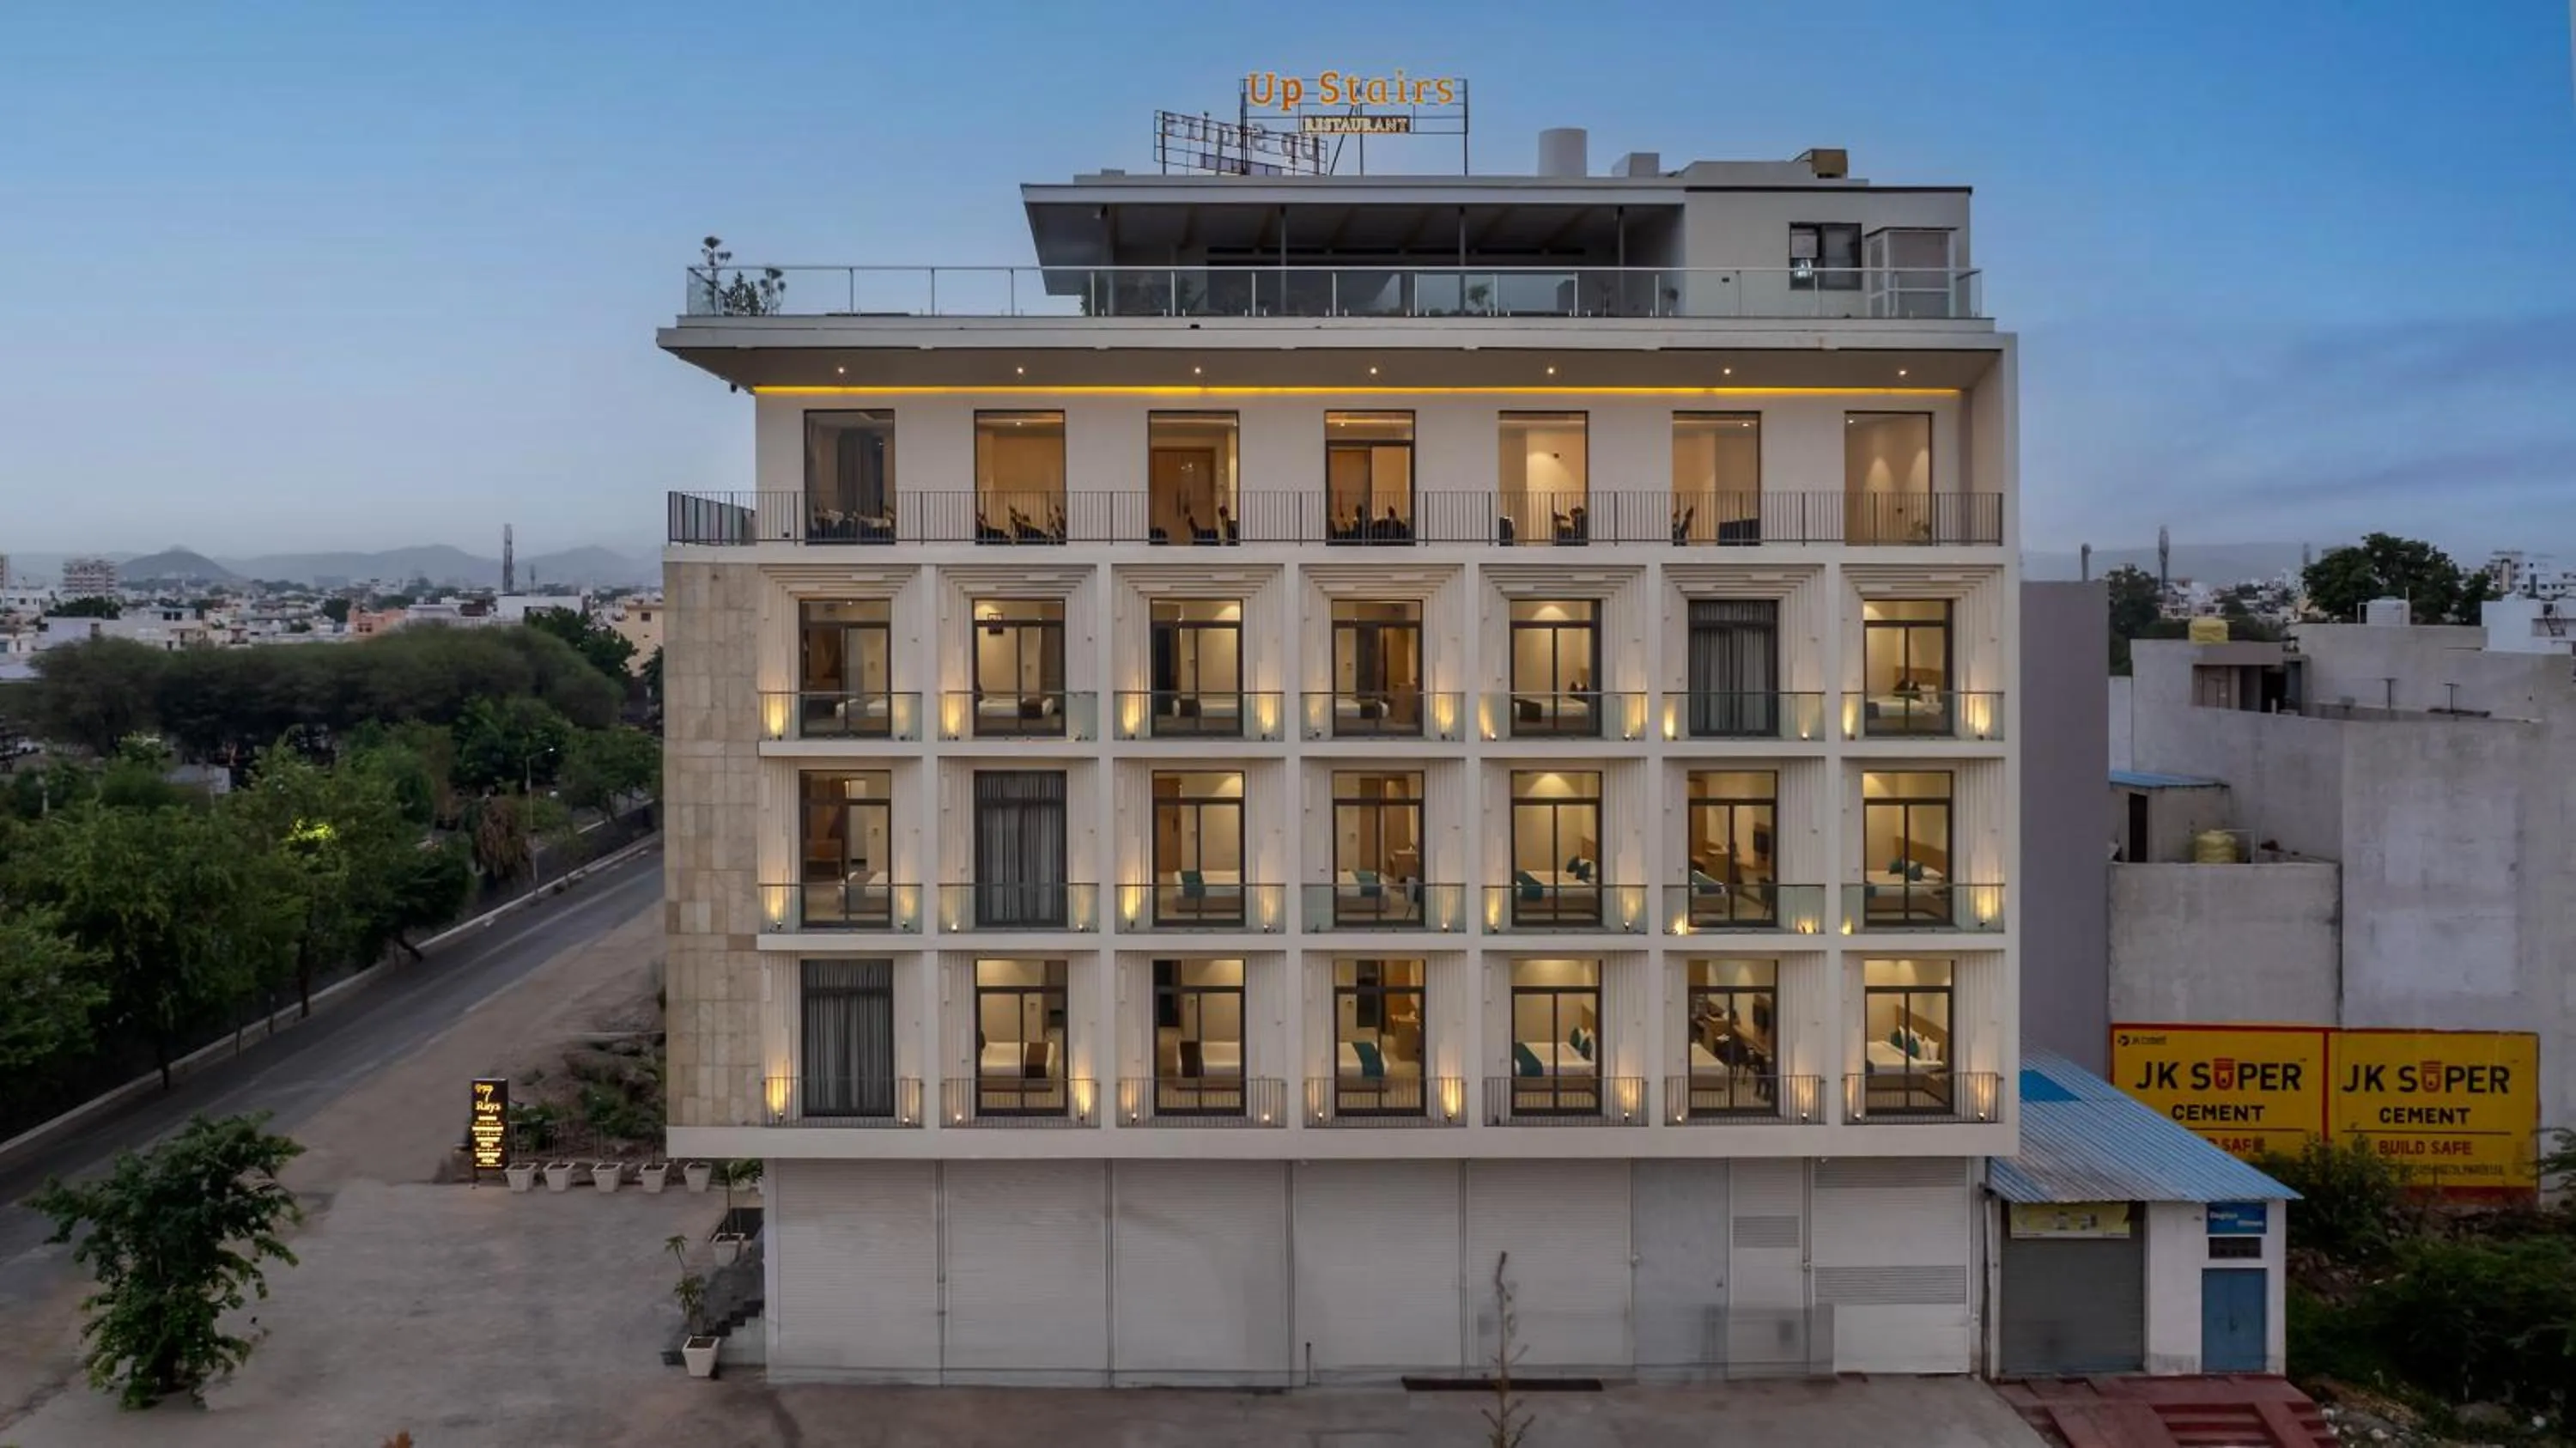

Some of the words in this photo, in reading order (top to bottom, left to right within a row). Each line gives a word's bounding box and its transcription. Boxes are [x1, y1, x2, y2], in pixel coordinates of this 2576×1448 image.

[1249, 71, 1303, 110] Up
[1319, 70, 1455, 104] Stairs
[2136, 1061, 2180, 1090] JK
[2190, 1058, 2302, 1092] SUPER
[2342, 1064, 2386, 1092] JK
[2398, 1061, 2510, 1094] SUPER
[2171, 1104, 2265, 1123] CEMENT
[2379, 1107, 2471, 1125] CEMENT
[2379, 1140, 2426, 1156] BUILD
[2431, 1140, 2474, 1156] SAFE
